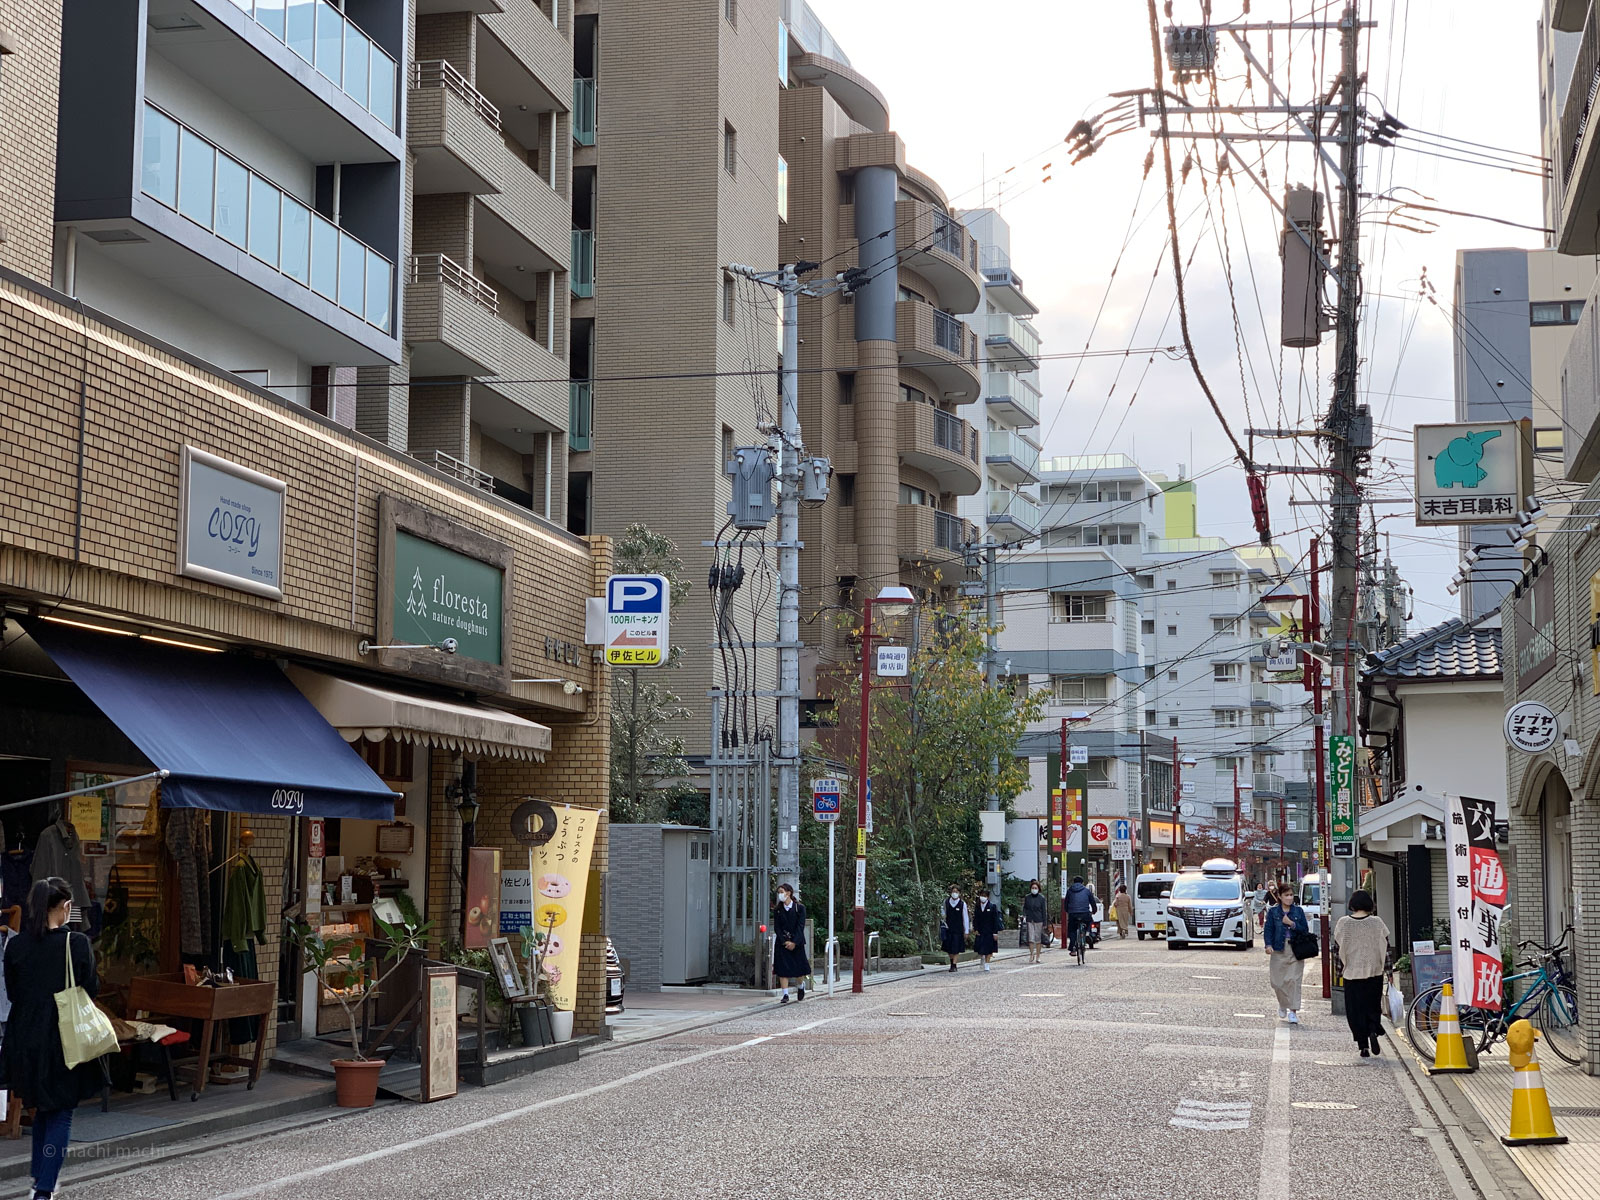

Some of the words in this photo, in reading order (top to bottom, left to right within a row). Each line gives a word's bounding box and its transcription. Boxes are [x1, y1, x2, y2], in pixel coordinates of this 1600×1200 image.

[219, 495, 231, 506] Hand
[231, 499, 241, 509] made
[241, 502, 251, 513] shop
[1423, 497, 1514, 516] 末吉耳鼻科
[208, 507, 261, 557] COZY
[251, 566, 263, 577] Since
[432, 575, 488, 620] floresta
[612, 580, 658, 611] P
[432, 611, 455, 627] nature
[456, 616, 488, 637] doughnuts
[610, 615, 659, 624] 100円パーキング
[610, 650, 657, 661] 伊佐ビル
[880, 663, 904, 671] 商店街
[1512, 726, 1553, 736] チキン
[1514, 712, 1553, 726] シブヤ
[1335, 742, 1352, 820] みどり歯科
[271, 789, 304, 814] COZY
[556, 815, 572, 861] どうぶつ
[572, 817, 586, 864] フロレスタの
[501, 877, 531, 887] 佐ビル
[1452, 811, 1471, 951] 施術受付中
[1467, 802, 1504, 1005] 交通事故
